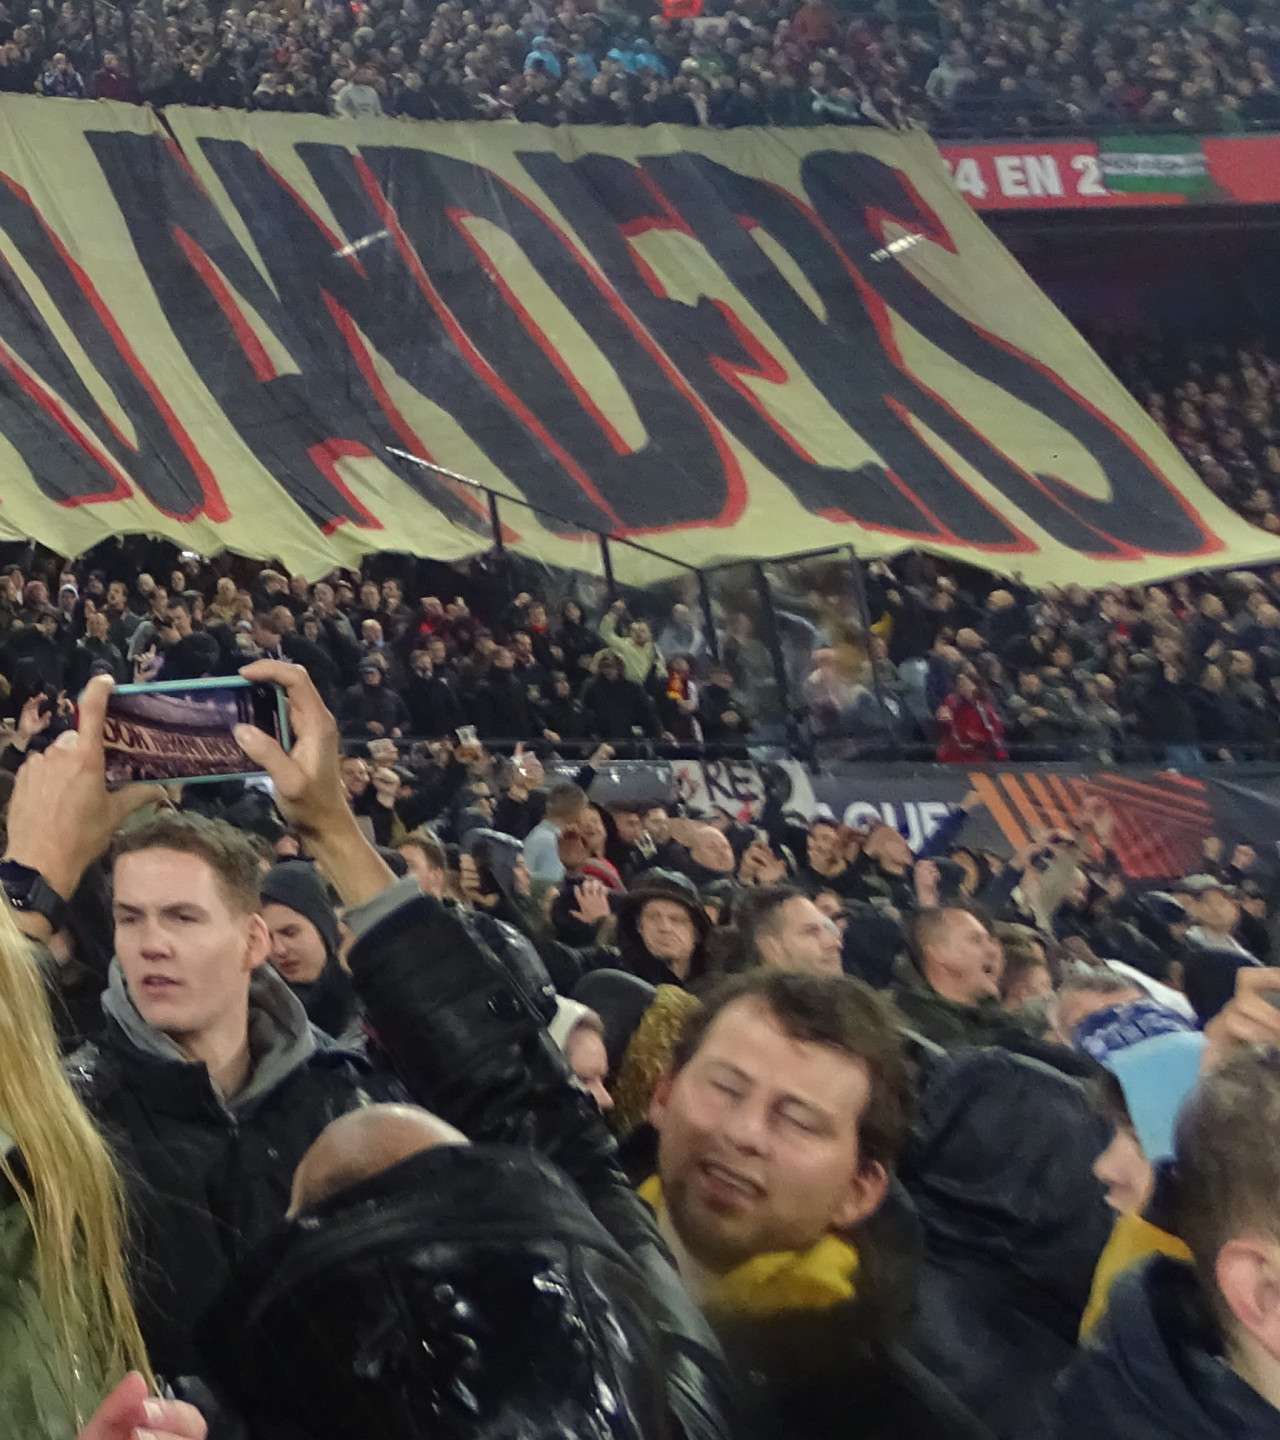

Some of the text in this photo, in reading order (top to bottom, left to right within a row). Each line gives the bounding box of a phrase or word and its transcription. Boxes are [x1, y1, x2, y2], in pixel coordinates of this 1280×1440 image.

[943, 157, 989, 199] 4
[993, 155, 1065, 197] EN
[83, 128, 1227, 561] ANDERS
